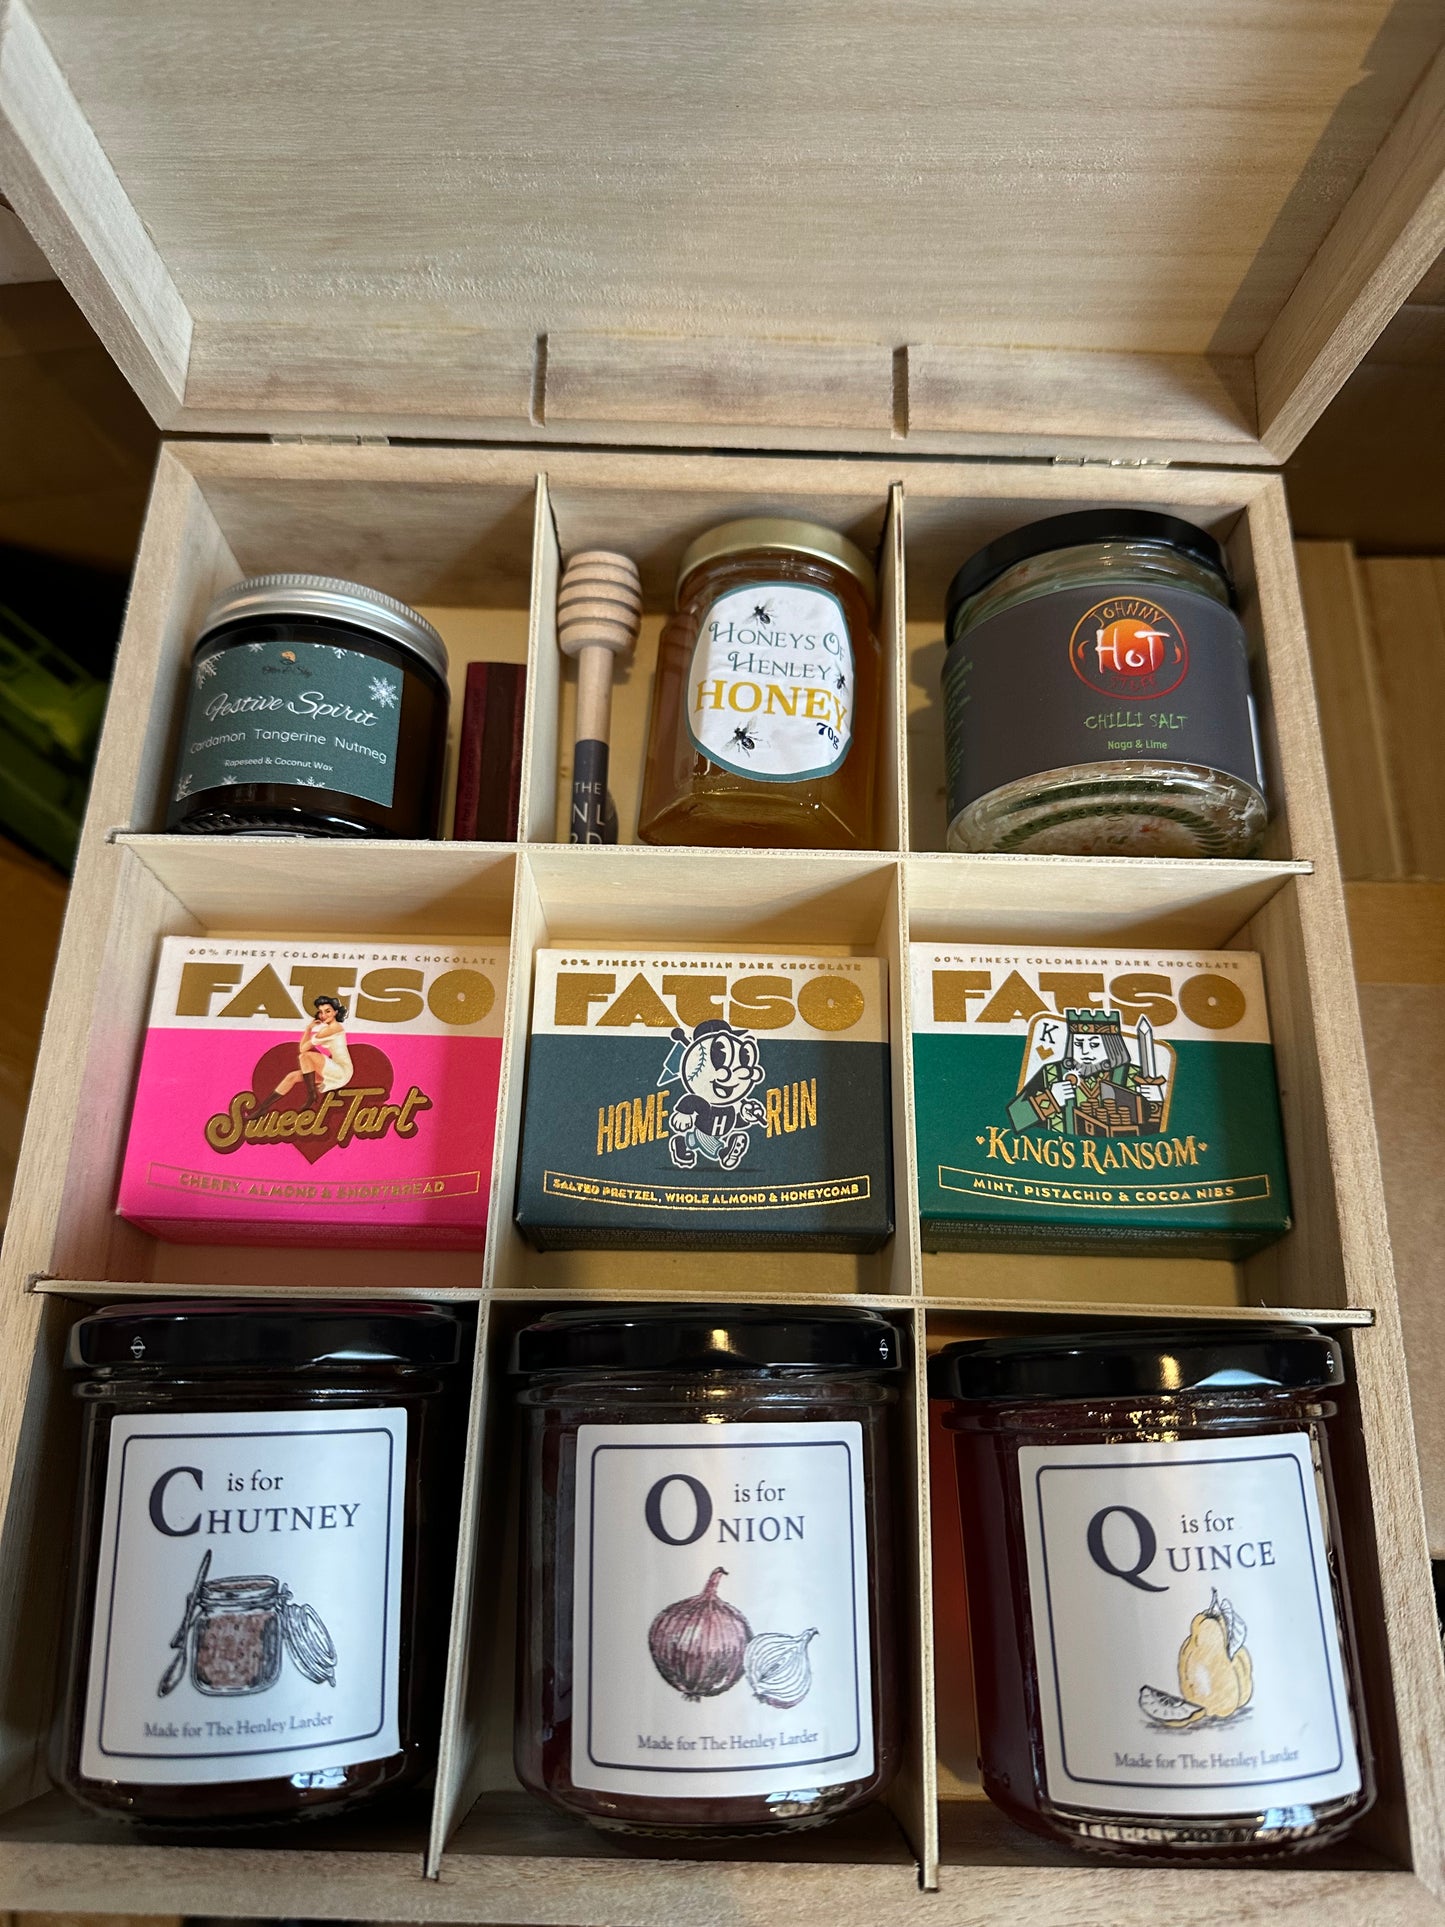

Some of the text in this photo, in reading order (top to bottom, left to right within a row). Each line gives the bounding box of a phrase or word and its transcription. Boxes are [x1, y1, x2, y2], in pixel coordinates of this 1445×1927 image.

[1088, 601, 1165, 629] JOHNNY
[708, 621, 815, 650] HONEYS
[728, 651, 832, 680] HENLEY
[205, 691, 379, 727] Festive Spirit
[694, 679, 848, 734] HONEY
[1084, 709, 1188, 729] CHILLI SALT
[254, 728, 326, 745] Tangerine
[335, 737, 387, 764] Nutmeg
[816, 722, 840, 751] 70g
[1107, 739, 1168, 750] Naga & Lime
[224, 756, 334, 772] Rapeseed & Coconut Wax
[575, 782, 602, 795] THE
[189, 948, 496, 966] 60% FINEST COLOMBIAN DARK CHOCOLATE
[560, 958, 862, 972] 60% FINEST COLOMBIAN DARK CHOCOLATE
[934, 955, 1240, 970] 60% FINEST COLOMBIAN DARK CHOCOLATE
[175, 962, 496, 1026] FATSO
[554, 971, 865, 1032] FATSO
[932, 969, 1247, 1030] FATSO
[1039, 1022, 1059, 1044] K
[206, 1086, 430, 1149] Sweet Tart
[596, 1078, 818, 1156] HOME RUN
[712, 1115, 726, 1136] H
[985, 1126, 1200, 1175] KING'S RANSOM
[249, 1184, 317, 1199] ALMOND
[320, 1187, 332, 1199] &
[336, 1180, 446, 1199] SHORTBREAD
[552, 1178, 860, 1205] SALTED PRETZEL, WHOLE ALMOND & HONEYCOMB
[972, 1177, 1236, 1202] MINT, PISTACHIO & COCOA NIBS
[227, 1469, 284, 1492] is for
[734, 1480, 786, 1503] is for
[1181, 1510, 1235, 1534] is for
[144, 1712, 334, 1740] Made for The Henley Larder
[637, 1729, 819, 1751] Made for The Henley Larder
[1114, 1747, 1299, 1770] Made for The Henley Larder
